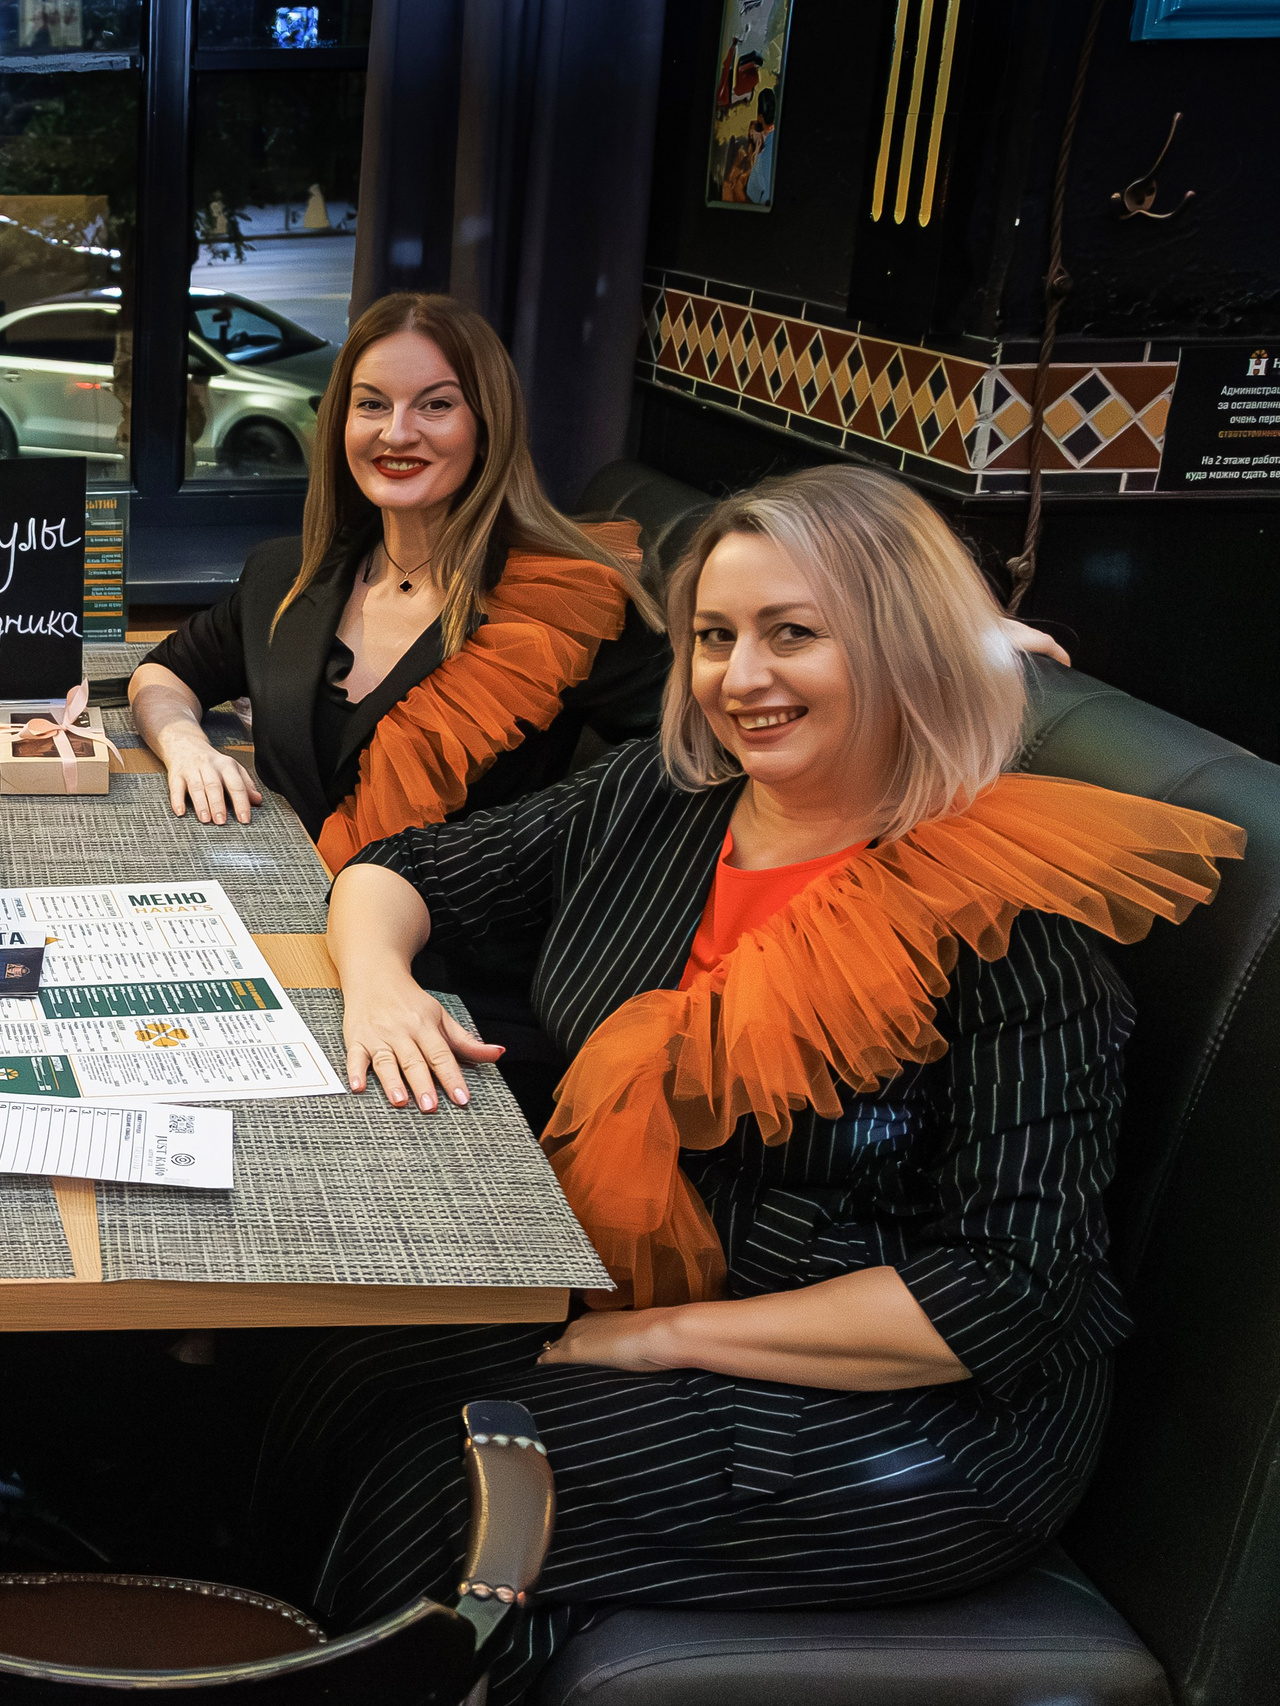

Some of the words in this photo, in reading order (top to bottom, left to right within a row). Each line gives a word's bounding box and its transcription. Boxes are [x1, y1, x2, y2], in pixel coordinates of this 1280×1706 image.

[1217, 401, 1229, 410] за
[1229, 415, 1257, 424] очень
[1201, 455, 1214, 465] На
[1215, 455, 1222, 465] 2
[1223, 456, 1251, 465] этаже
[1185, 471, 1208, 482] куда
[1209, 471, 1240, 479] можно
[1241, 471, 1268, 480] сдать
[128, 892, 207, 907] МЕНЮ
[155, 1135, 168, 1155] JUST
[154, 1156, 168, 1177] КАЙФ
